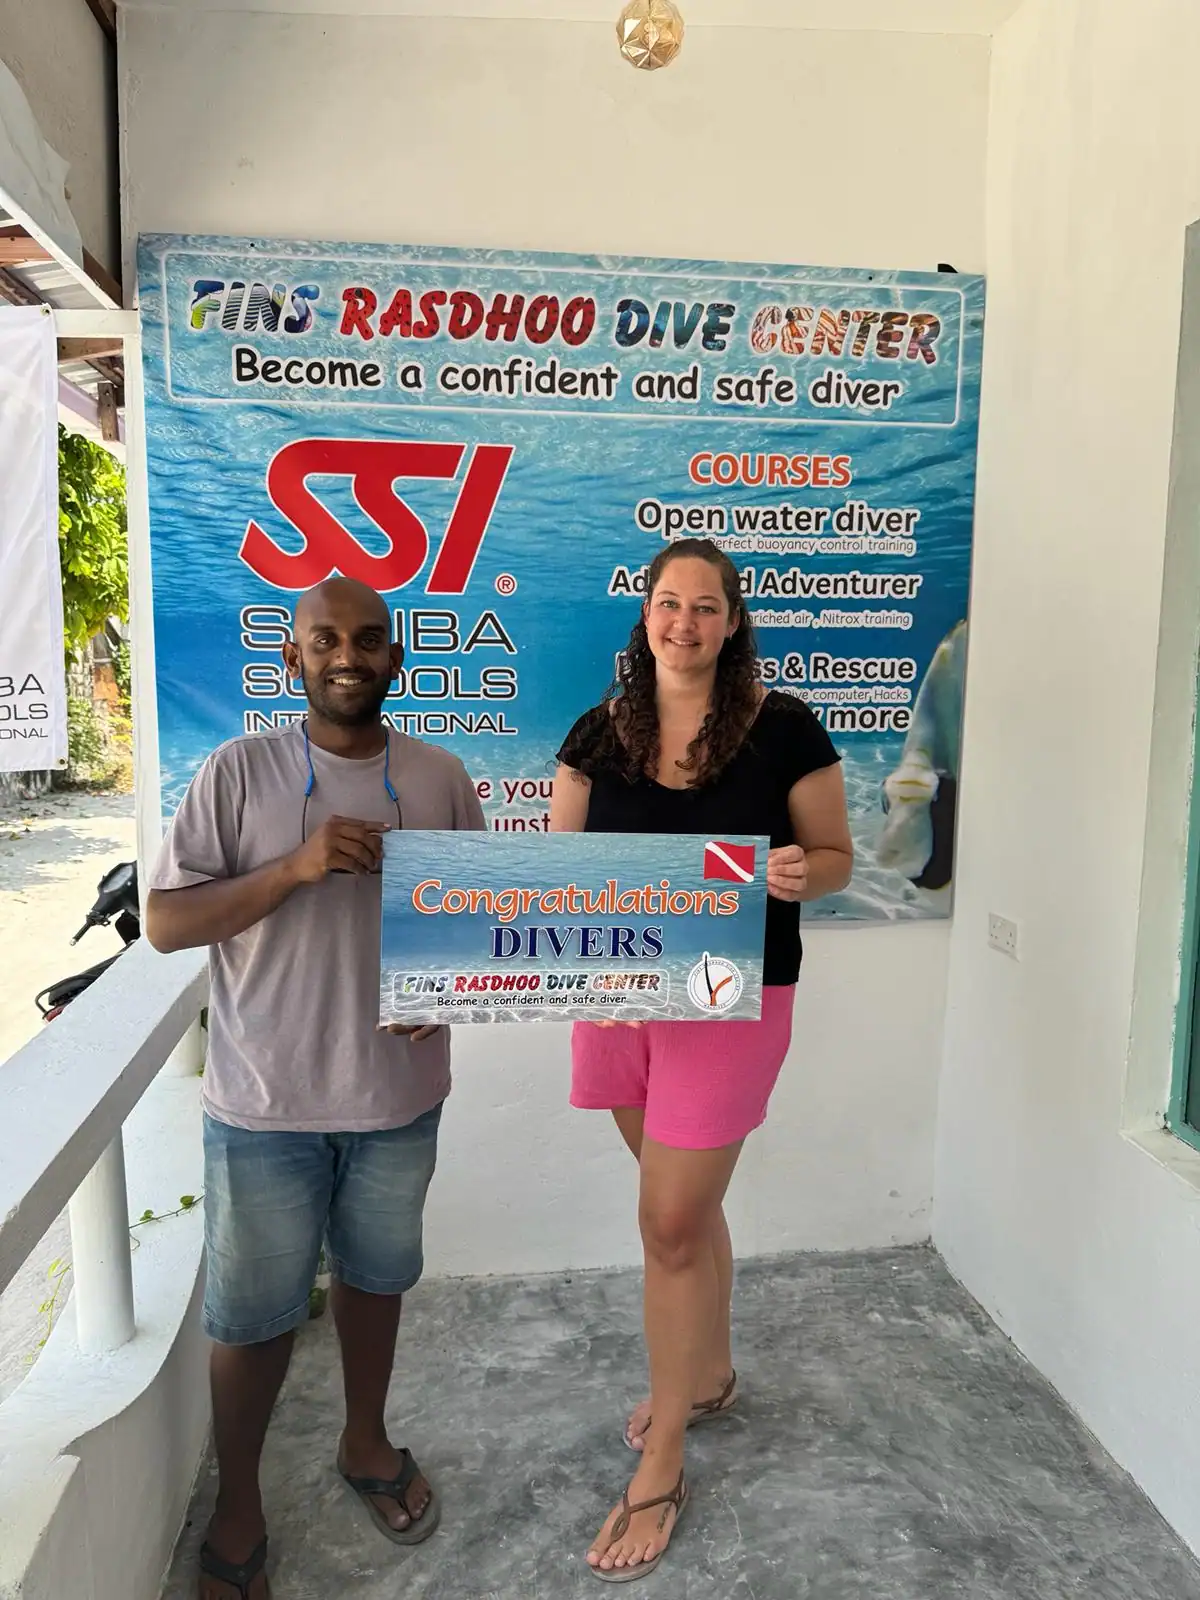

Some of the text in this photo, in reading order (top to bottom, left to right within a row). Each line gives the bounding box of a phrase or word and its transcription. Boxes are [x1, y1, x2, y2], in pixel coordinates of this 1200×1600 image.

[190, 279, 941, 365] FINS RASDHOO DIVE CENTER
[235, 347, 899, 406] Become a confident and safe diver
[690, 452, 852, 487] COURSES
[238, 438, 515, 594] SSI
[638, 501, 919, 535] Open water diver
[757, 536, 815, 552] buoyancy
[820, 538, 864, 552] control
[868, 540, 914, 554] training
[761, 570, 920, 597] Adventurer
[794, 612, 811, 624] air
[822, 613, 860, 625] Nitrox
[865, 613, 910, 627] training
[784, 655, 804, 680] &
[812, 656, 914, 681] Rescue
[874, 690, 909, 701] Hacks
[829, 708, 910, 730] more
[412, 879, 740, 922] Congratulations
[489, 926, 664, 959] DIVERS
[404, 973, 660, 993] FINS RASDHOO DIVE CENTER
[437, 993, 627, 1006] Become a confident and safe diver
